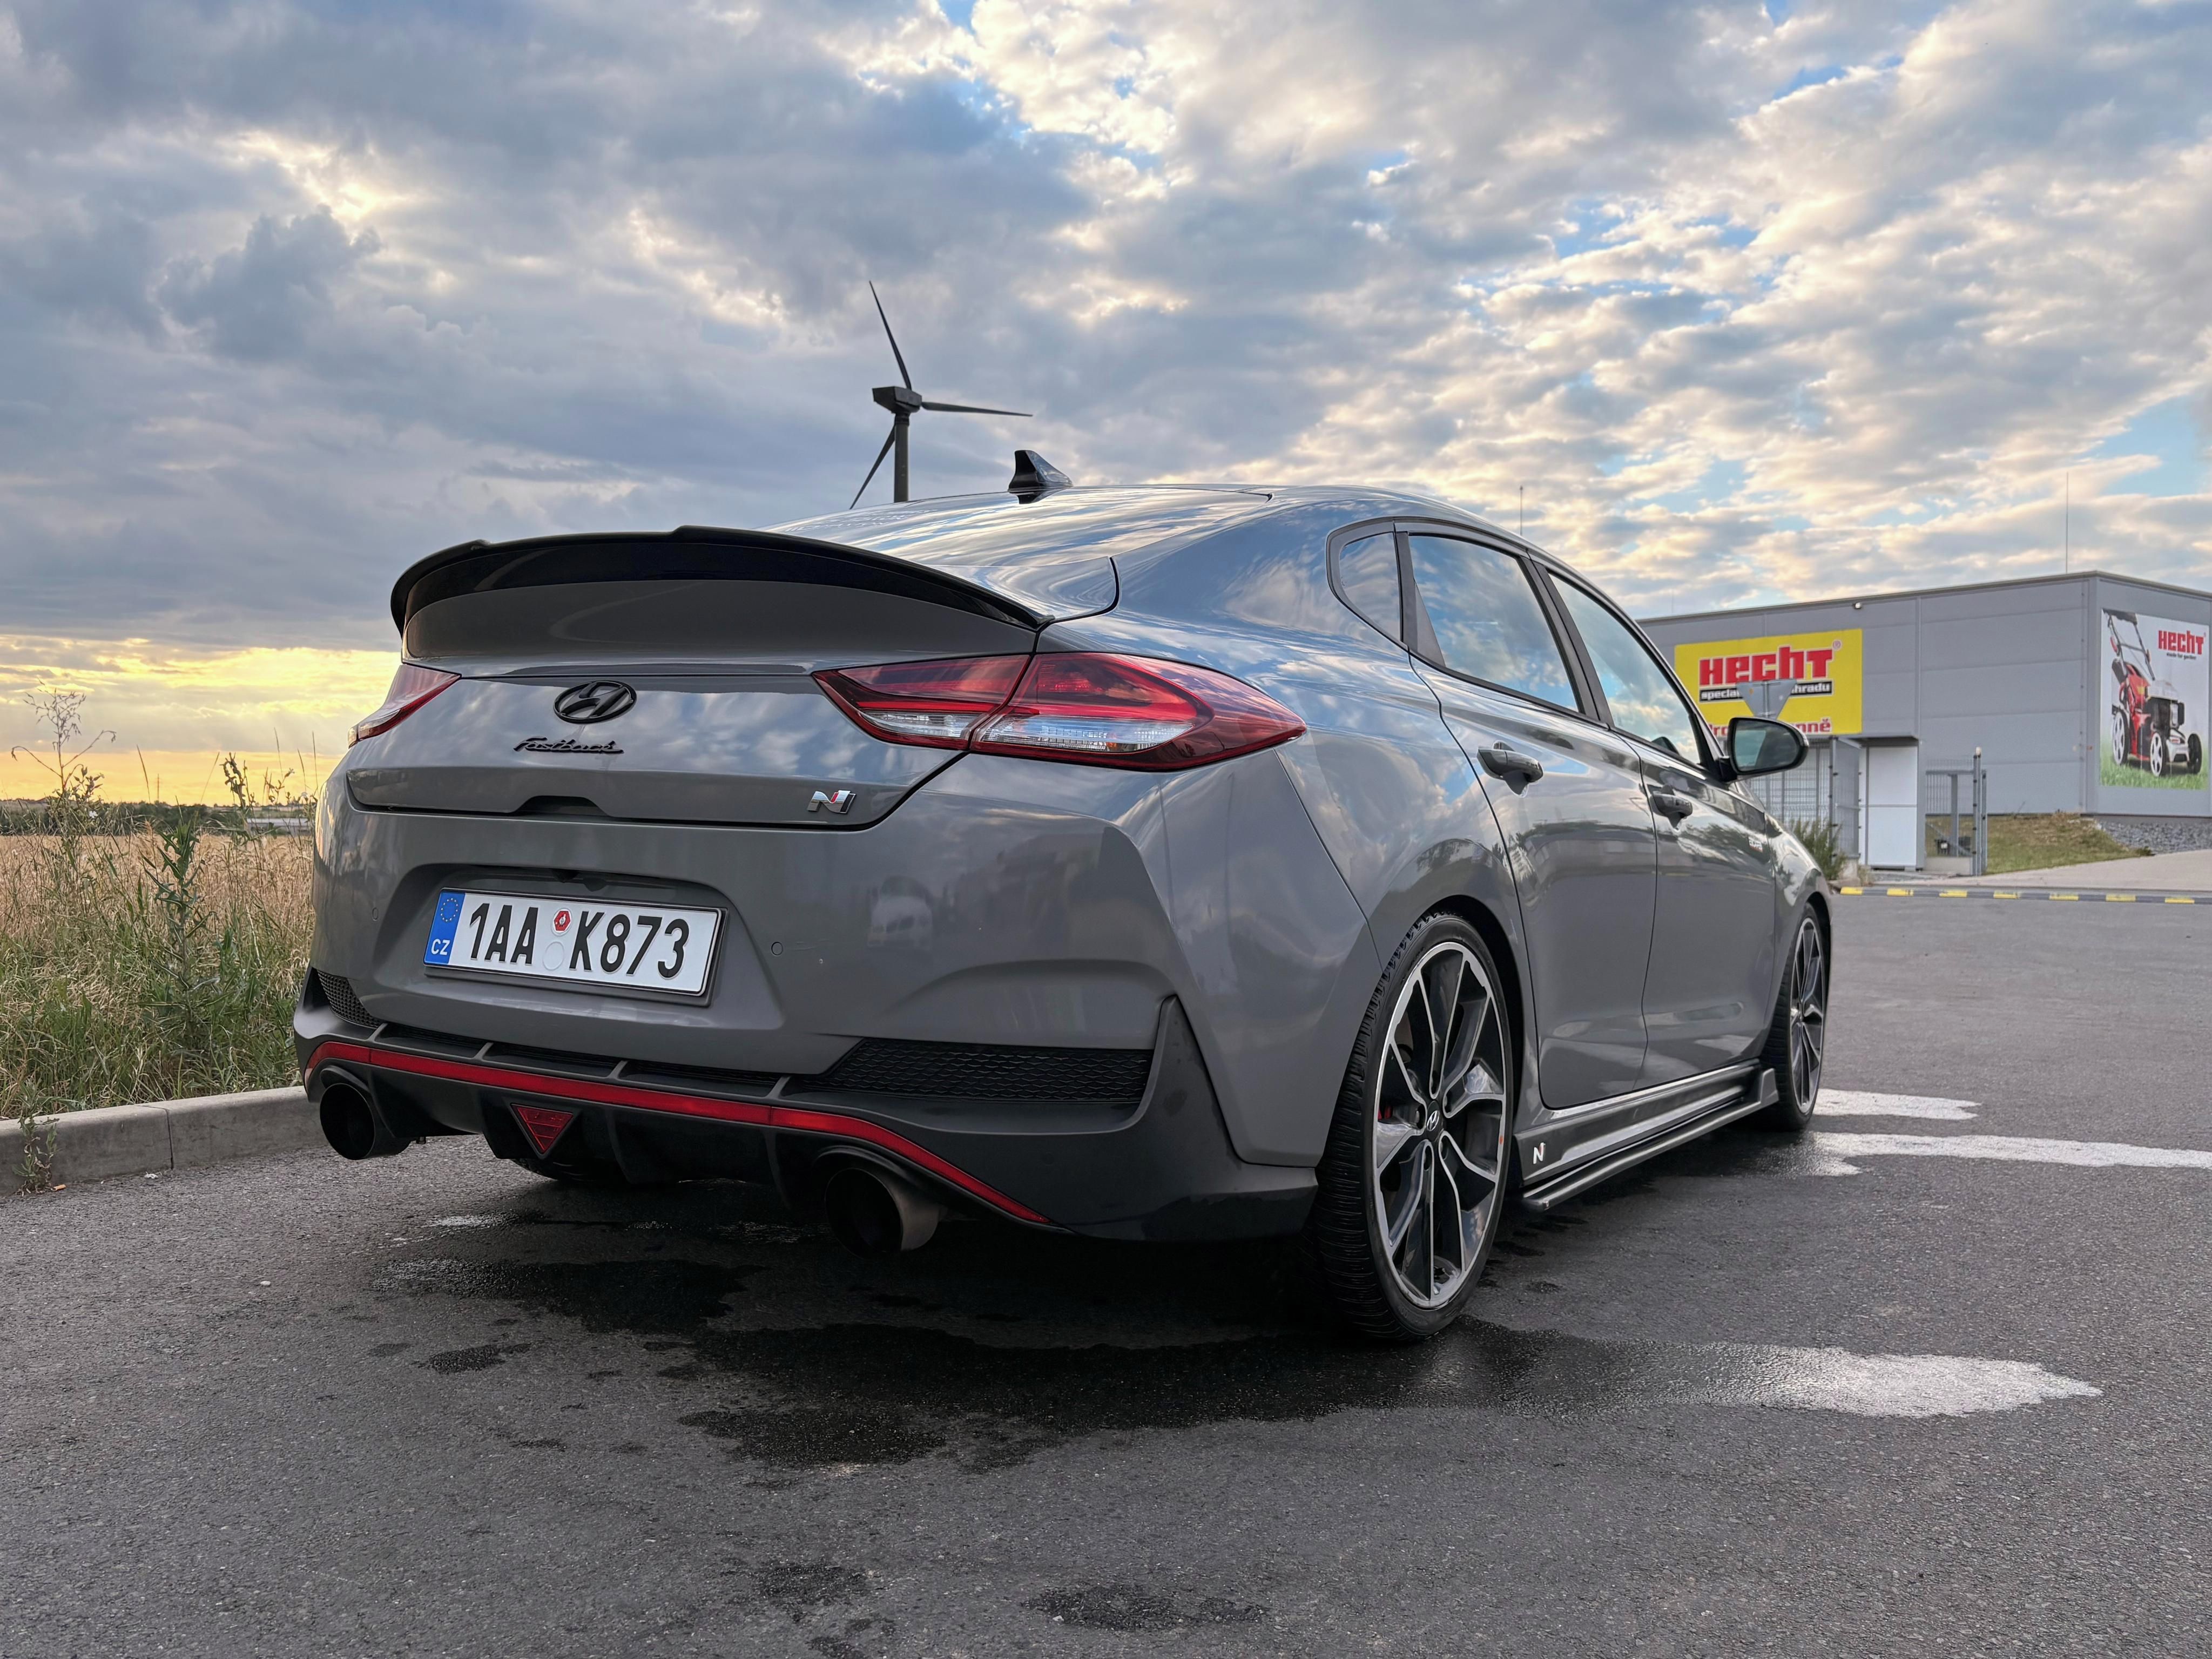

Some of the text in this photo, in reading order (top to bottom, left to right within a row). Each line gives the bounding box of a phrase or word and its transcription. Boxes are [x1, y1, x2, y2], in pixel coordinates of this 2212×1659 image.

[431, 938, 449, 956] CZ
[470, 902, 689, 980] 1AA K873
